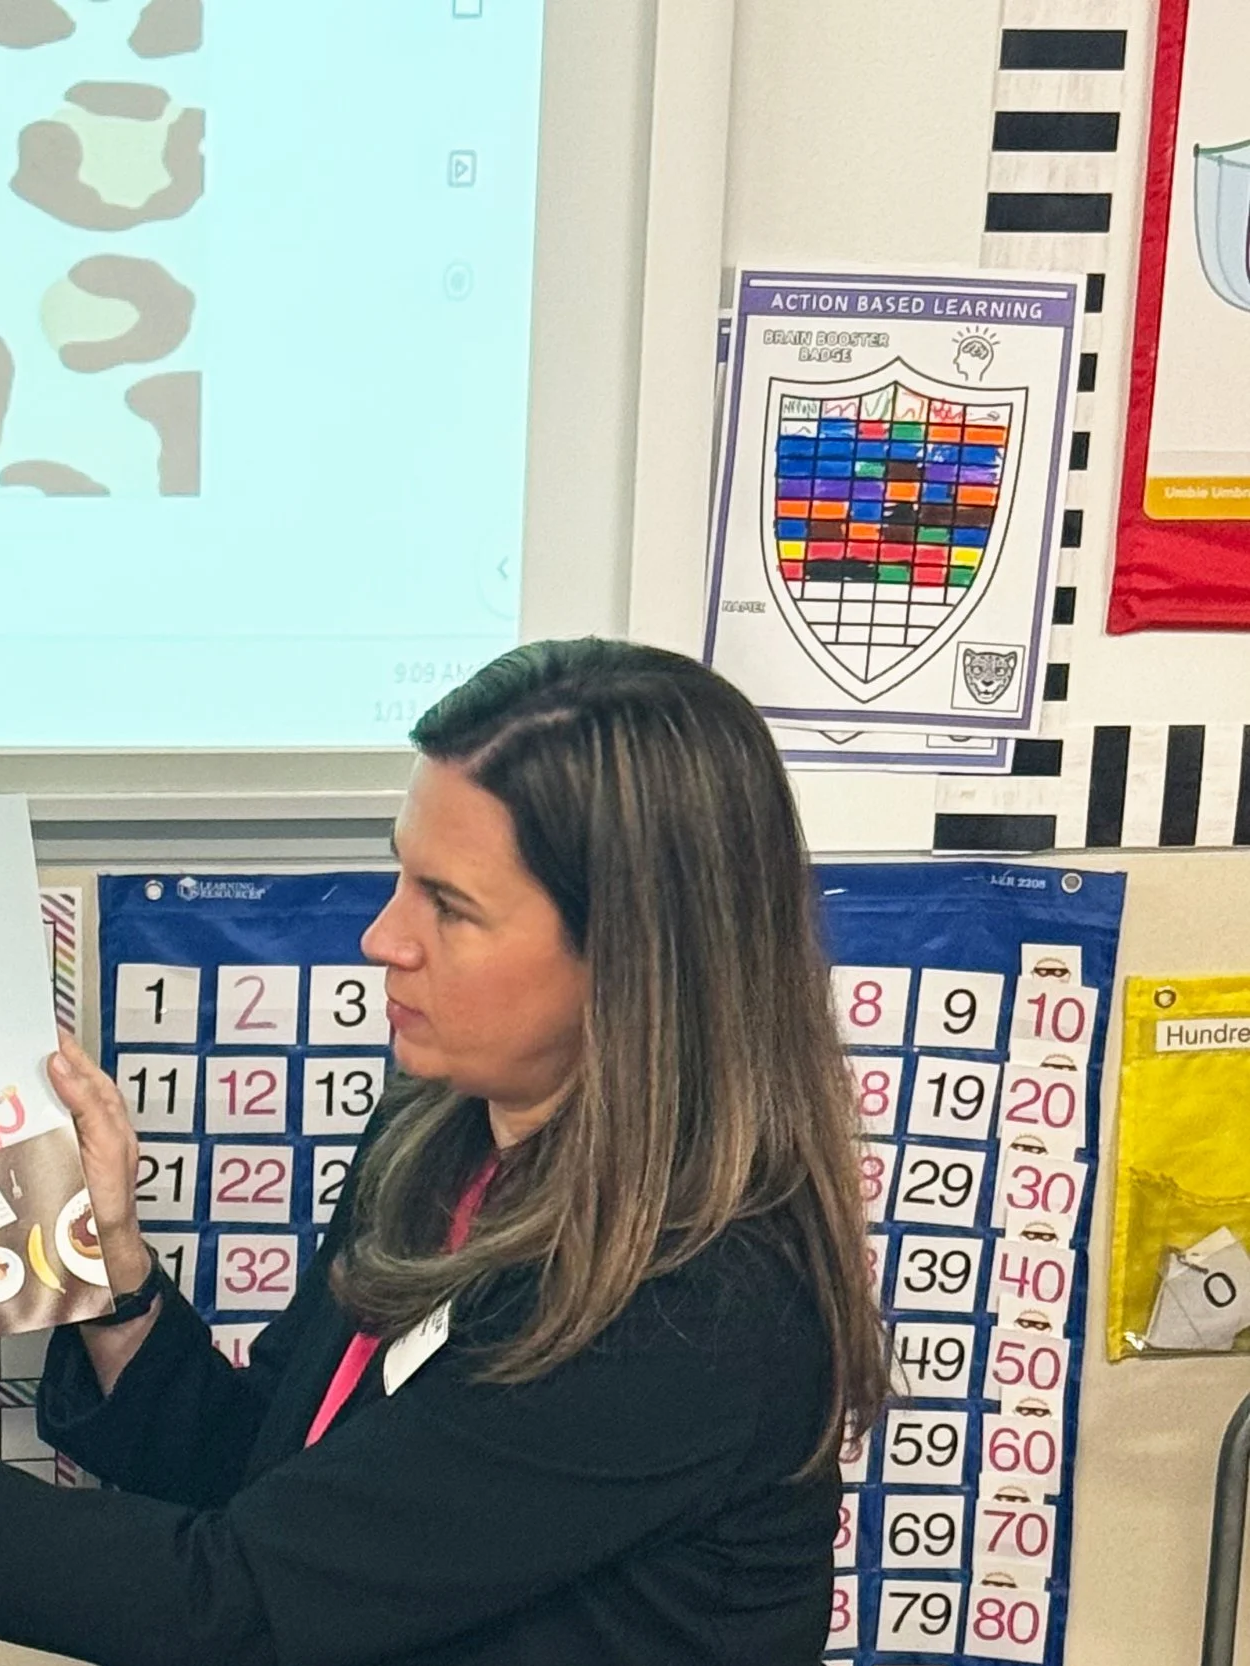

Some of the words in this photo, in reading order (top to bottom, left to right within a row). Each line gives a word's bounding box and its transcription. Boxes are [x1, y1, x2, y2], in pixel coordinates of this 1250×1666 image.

[771, 293, 848, 312] ACTION
[857, 296, 924, 314] BASED
[933, 302, 1043, 319] LEARNING
[763, 329, 811, 345] BRAIN
[815, 331, 889, 348] BOOSTER
[798, 348, 851, 363] BADGE
[145, 978, 166, 1024] 1
[235, 976, 277, 1029] 2
[333, 980, 367, 1026] 3
[850, 980, 883, 1027] 8
[943, 989, 977, 1034] 9
[1028, 994, 1086, 1042] 10
[129, 1068, 179, 1114] 11
[219, 1070, 277, 1116] 12
[316, 1072, 374, 1117] 13
[859, 1070, 890, 1116] 8
[927, 1072, 985, 1120] 19
[1005, 1078, 1075, 1128] 20
[136, 1156, 184, 1202] 21
[217, 1158, 287, 1204] 22
[903, 1160, 973, 1207] 29
[1007, 1165, 1076, 1213] 30
[225, 1247, 291, 1294] 32
[904, 1249, 972, 1294] 39
[999, 1254, 1065, 1302] 40
[899, 1336, 966, 1381] 49
[992, 1342, 1061, 1389] 50
[890, 1423, 958, 1467] 59
[989, 1428, 1055, 1475] 60
[889, 1512, 956, 1557] 69
[982, 1510, 1049, 1557] 70
[888, 1592, 952, 1635] 79
[972, 1598, 1040, 1645] 80
